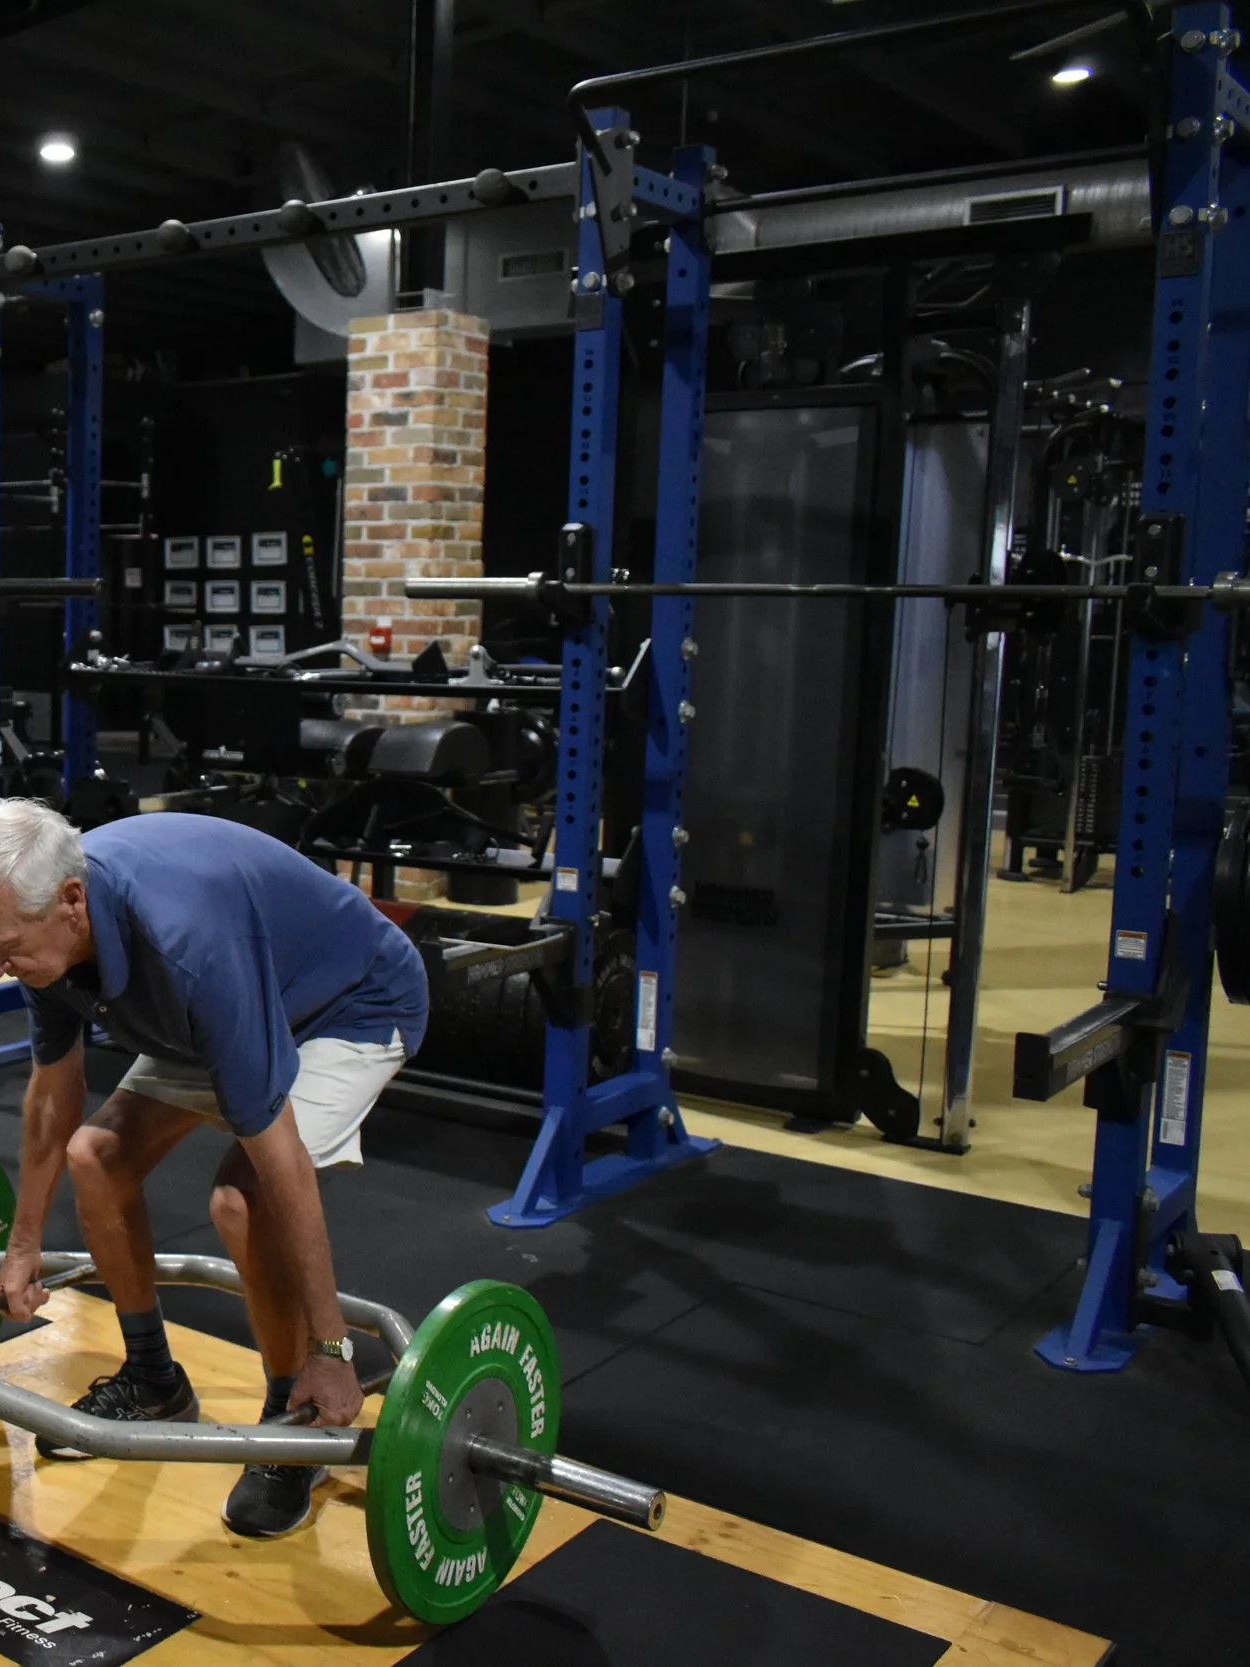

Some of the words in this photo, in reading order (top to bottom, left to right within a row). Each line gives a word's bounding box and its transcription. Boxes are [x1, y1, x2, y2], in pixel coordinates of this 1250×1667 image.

[469, 1321, 521, 1358] AGAIN
[518, 1343, 547, 1440] FASTER
[405, 1469, 436, 1571] FASTER
[434, 1544, 488, 1588] AGAIN
